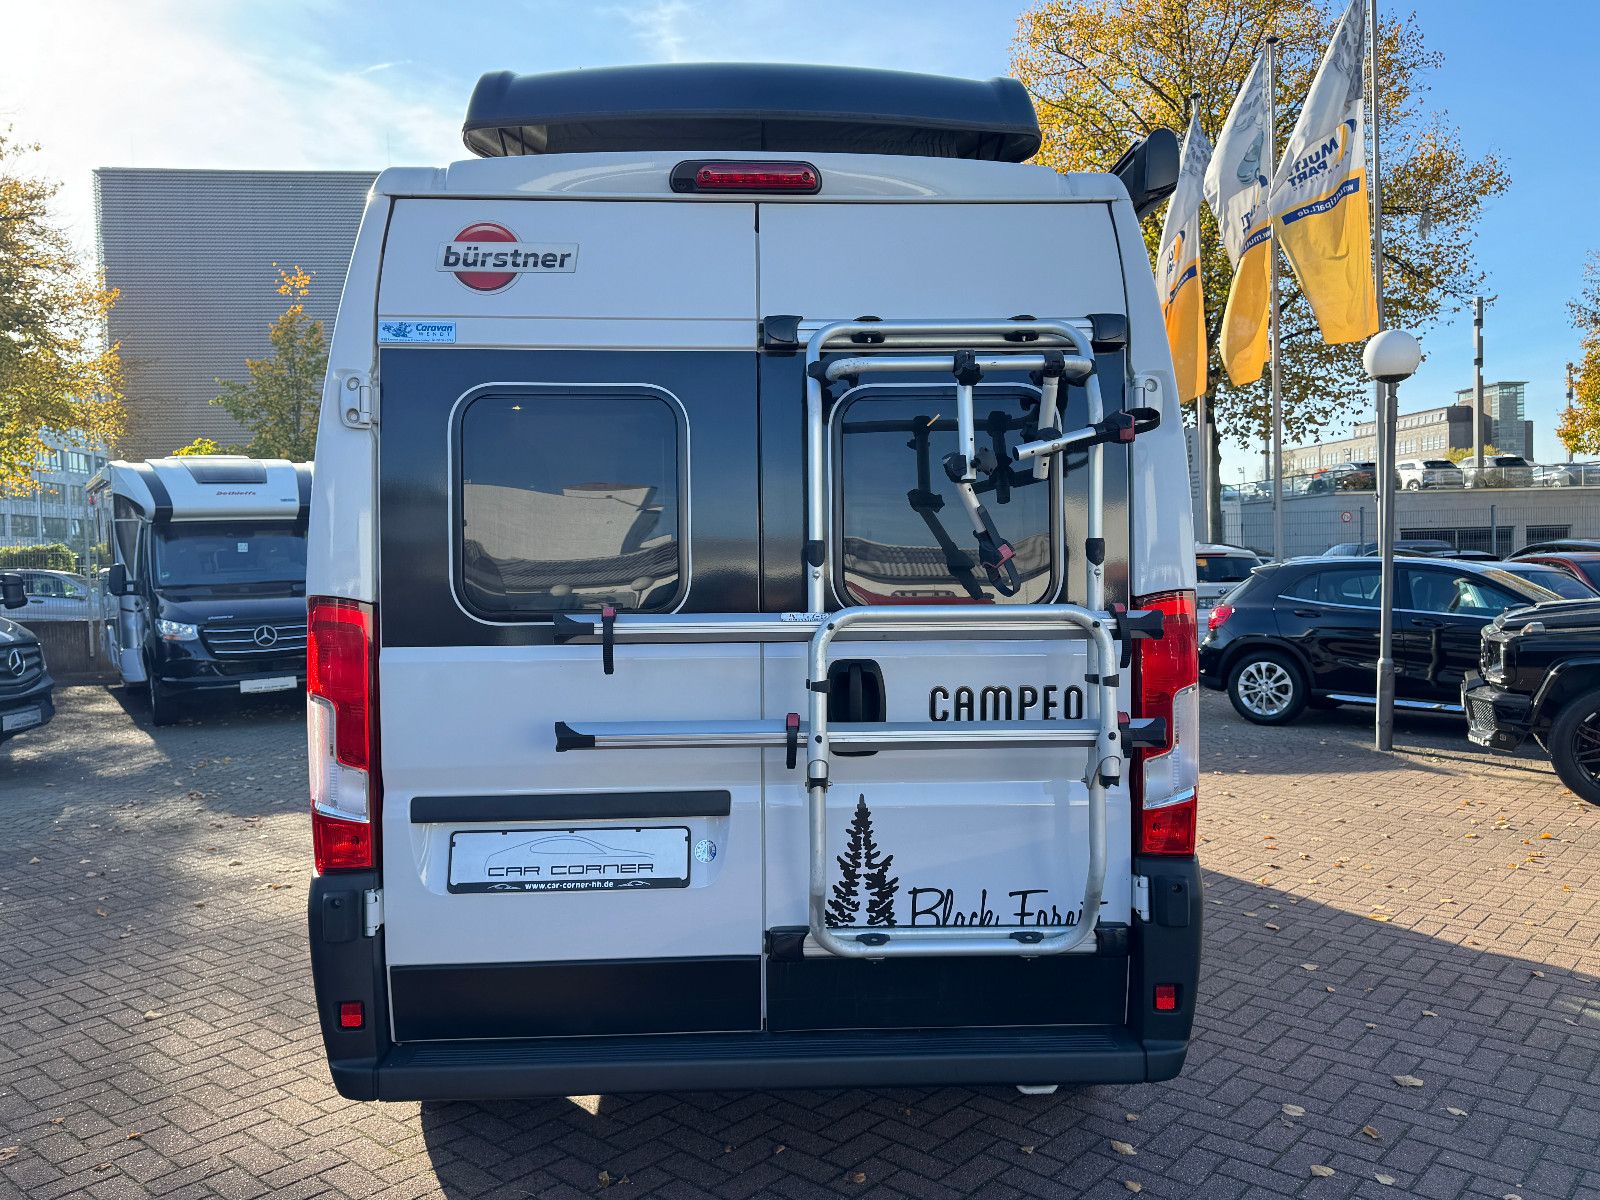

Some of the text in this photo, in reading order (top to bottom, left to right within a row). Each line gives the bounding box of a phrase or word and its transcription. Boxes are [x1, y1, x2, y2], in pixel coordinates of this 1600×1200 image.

[443, 246, 571, 268] bürstner
[415, 323, 453, 332] Caravan
[929, 685, 1084, 721] CAMPEO
[487, 863, 654, 877] CAR CORNER
[524, 881, 614, 890] www.car-corner-hh.de
